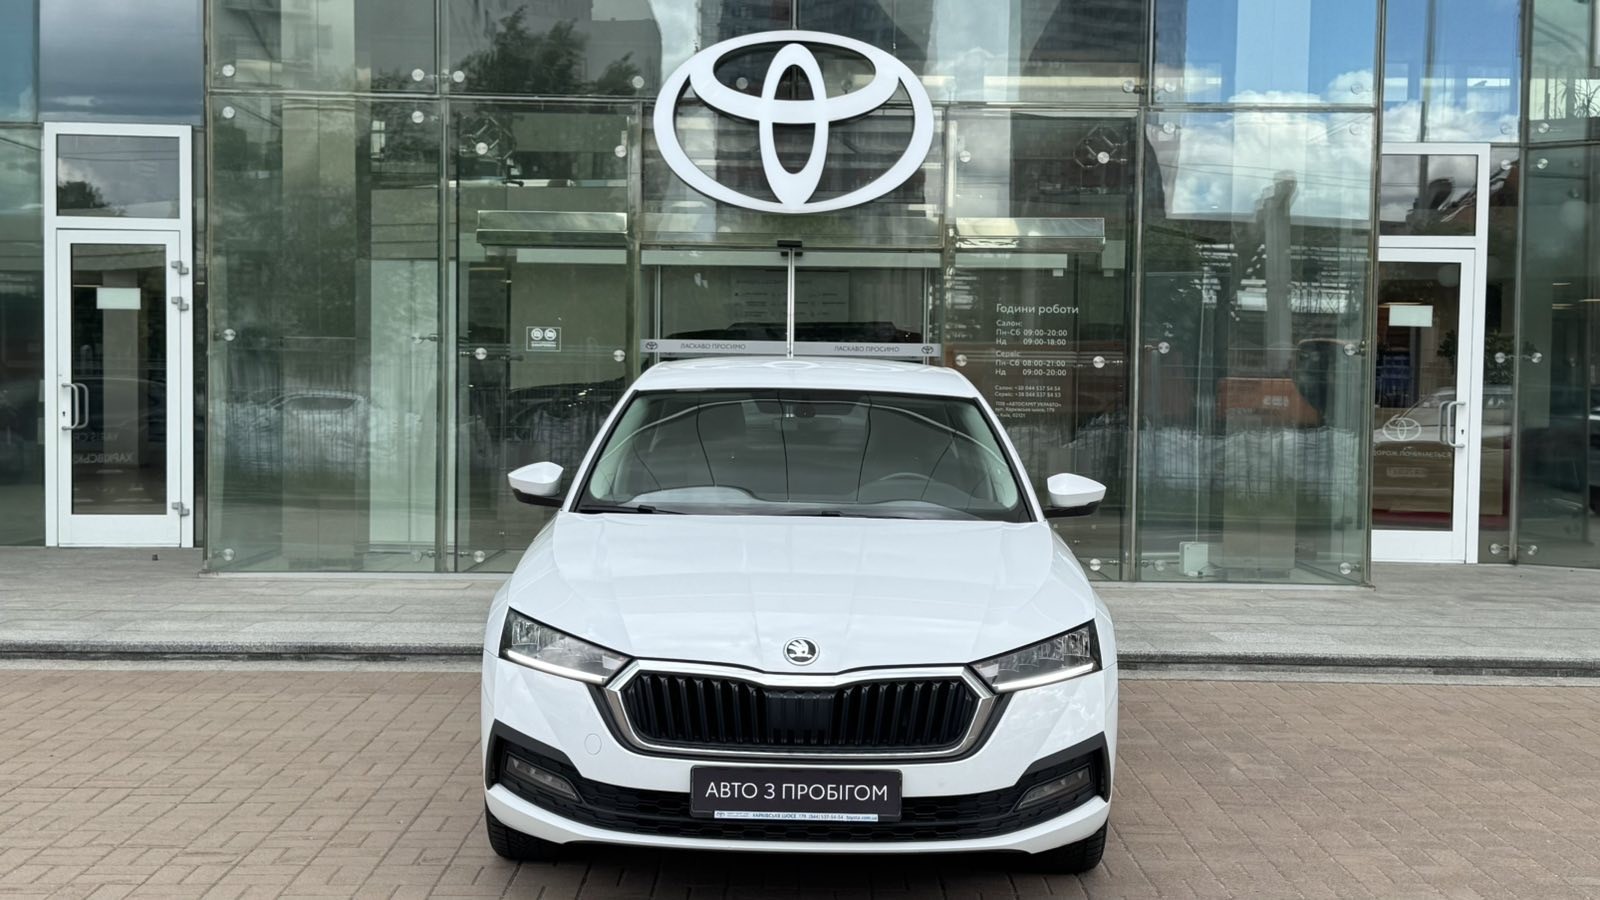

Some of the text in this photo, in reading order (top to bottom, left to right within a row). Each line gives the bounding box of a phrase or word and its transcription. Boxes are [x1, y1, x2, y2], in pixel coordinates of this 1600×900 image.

[996, 303, 1079, 316] Години роботи
[996, 319, 1023, 327] Салон:
[1023, 329, 1068, 337] 09:00-20:00
[995, 337, 1067, 346] Нд 09:00-18:00
[711, 343, 746, 351] ПРОСИМО
[834, 344, 900, 353] ЛАСКАВО ПРОСИМО
[1022, 359, 1066, 367] 08:00-21:00
[995, 368, 1067, 376] Нд 09:00-20:00
[705, 781, 758, 799] АВТО
[782, 783, 888, 801] ПРОБІГОМ
